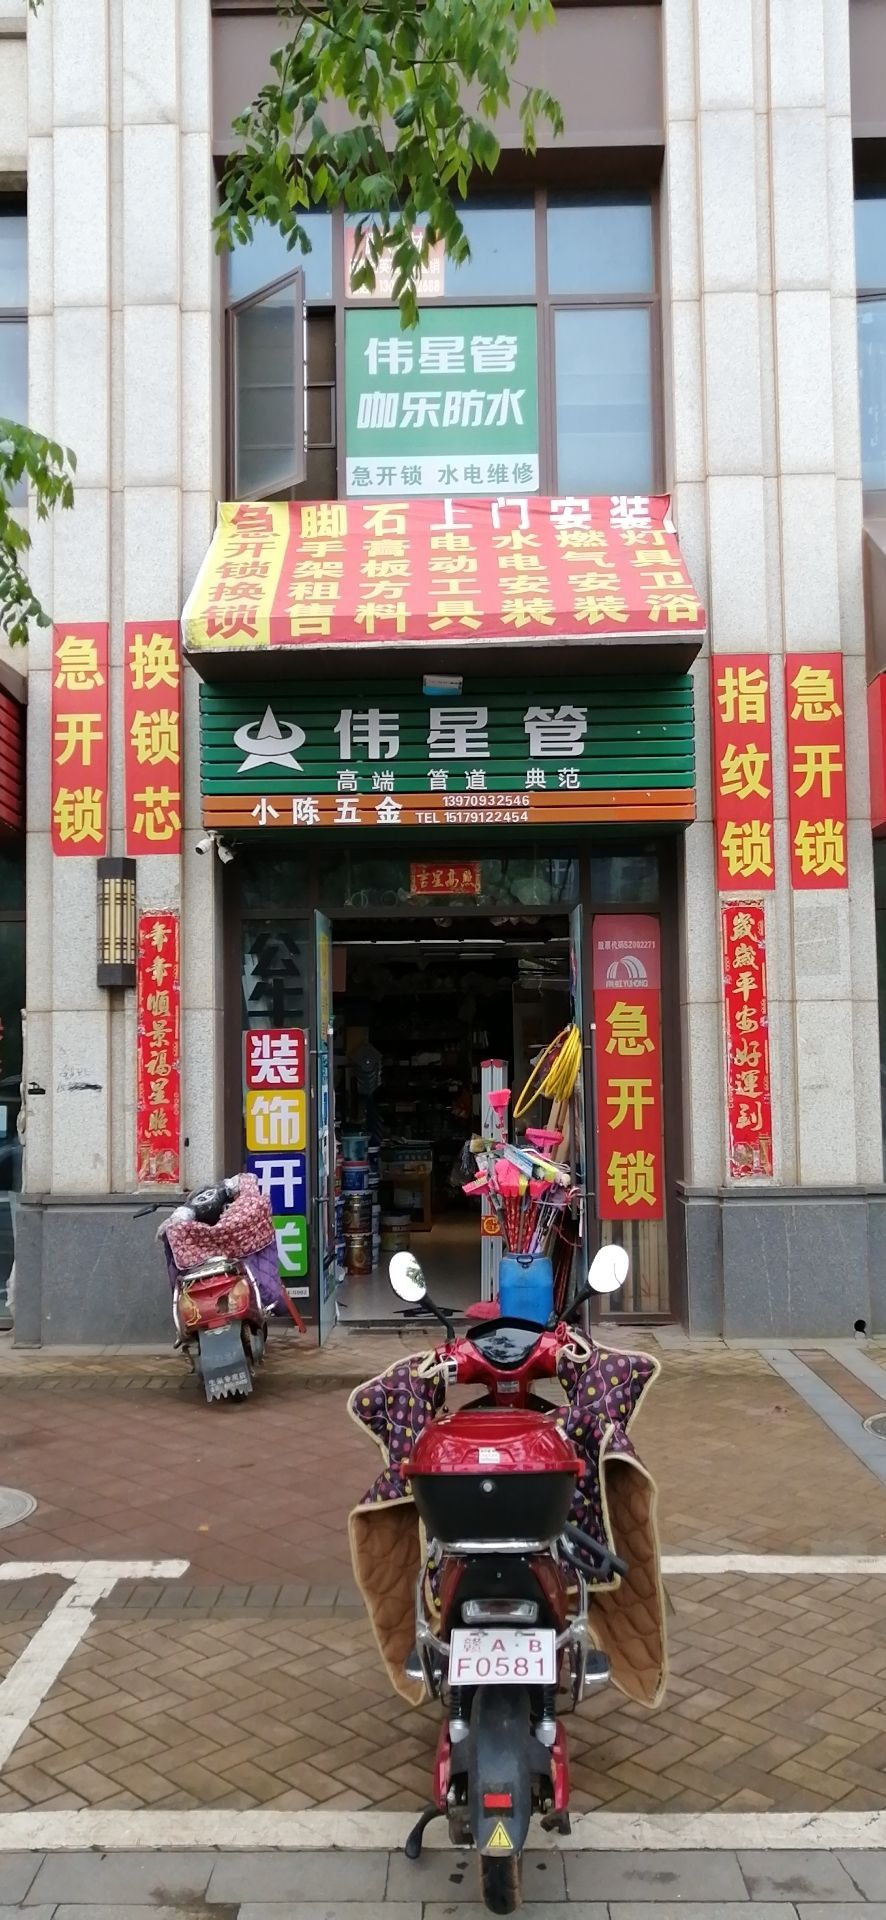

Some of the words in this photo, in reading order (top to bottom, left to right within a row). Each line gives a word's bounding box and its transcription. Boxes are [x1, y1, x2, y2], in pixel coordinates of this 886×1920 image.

[364, 335, 517, 374] 伟星管
[357, 388, 526, 428] 咖乐防水
[352, 465, 422, 486] 急开锁
[437, 462, 533, 485] 水电维修
[430, 496, 653, 531] 上门安装
[200, 503, 281, 639] 急开锁换锁
[284, 503, 348, 637] 脚手架租售
[354, 503, 412, 634] 石膏板方料
[427, 531, 484, 631] 电动工具
[492, 530, 557, 629] 水电安装
[555, 530, 630, 626] 燃气安装
[620, 529, 701, 623] 灯具卫浴
[53, 634, 105, 844] 急开锁
[129, 633, 182, 841] 换锁芯
[333, 705, 588, 760] 伟星管
[336, 769, 395, 791] 高端
[427, 768, 487, 791] 管道
[525, 767, 581, 789] 典范
[717, 666, 773, 878] 指纹锁
[790, 665, 846, 877] 急开锁
[251, 796, 403, 825] 小陈五金
[415, 812, 440, 823] TEL
[444, 811, 528, 823] 15179122454
[442, 795, 530, 807] 13970932546
[605, 1001, 656, 1207] 急开锁
[457, 1657, 544, 1677] F0581
